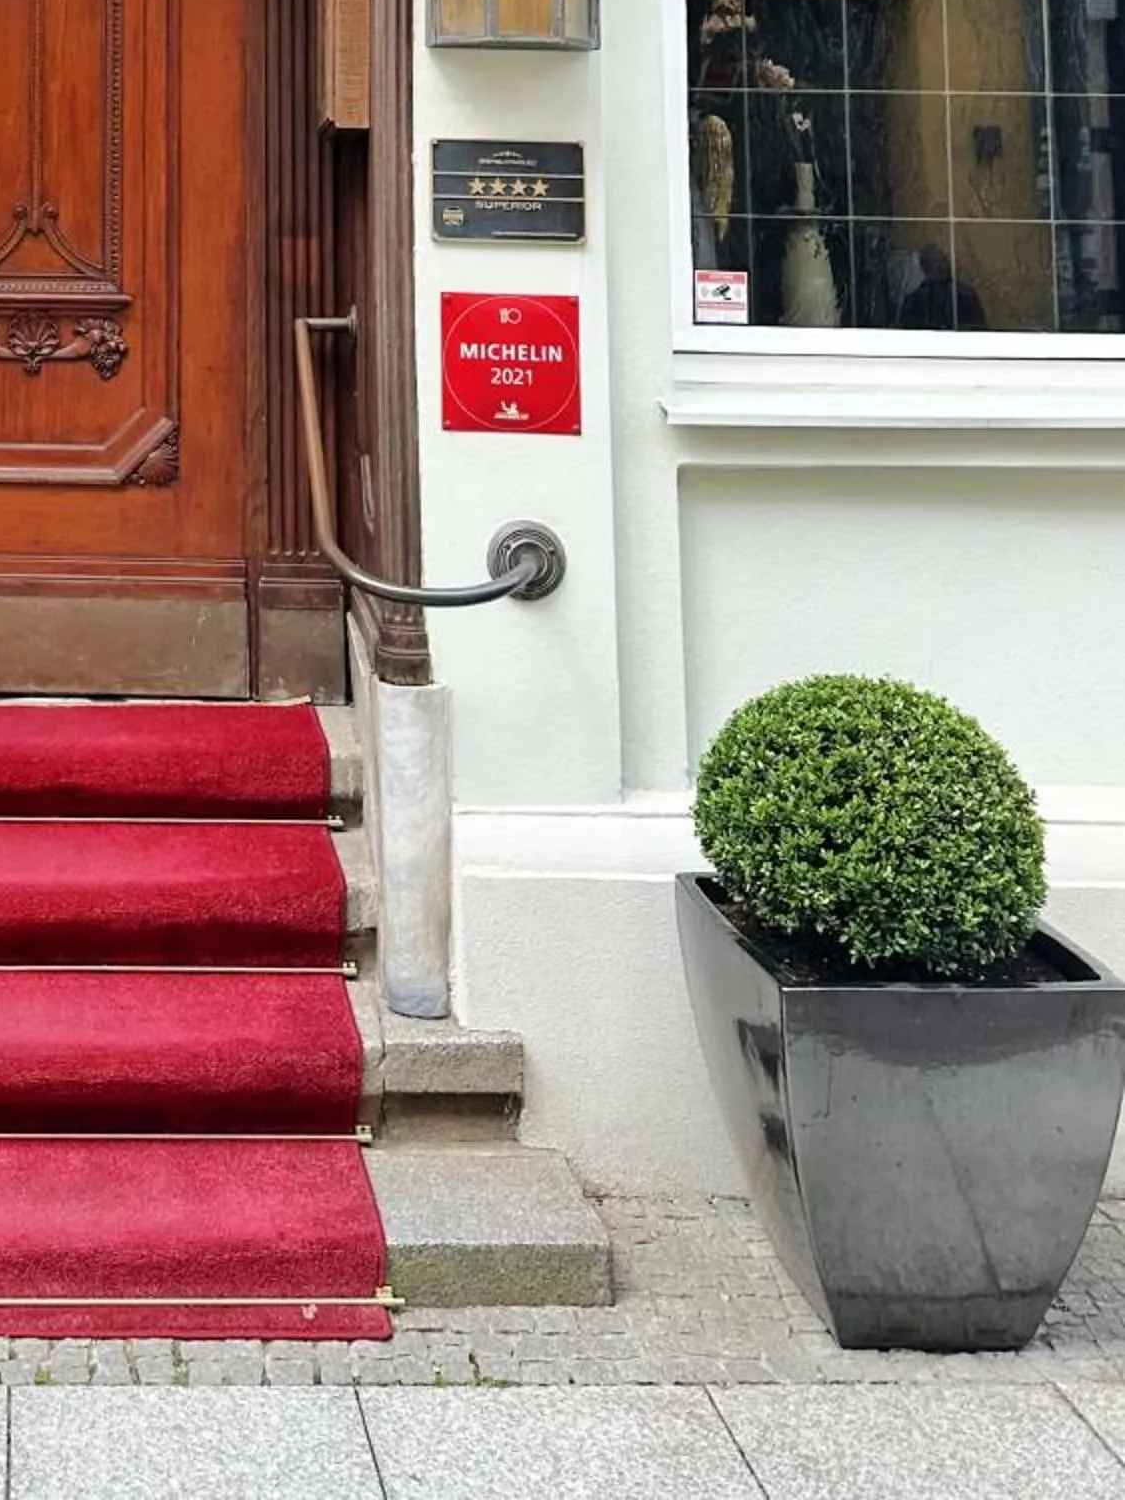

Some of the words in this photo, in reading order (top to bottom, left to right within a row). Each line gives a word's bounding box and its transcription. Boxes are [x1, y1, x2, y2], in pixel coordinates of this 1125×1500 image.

[474, 201, 543, 211] SUPERIOR
[460, 343, 563, 362] MICHELIN
[490, 367, 533, 385] 2021
